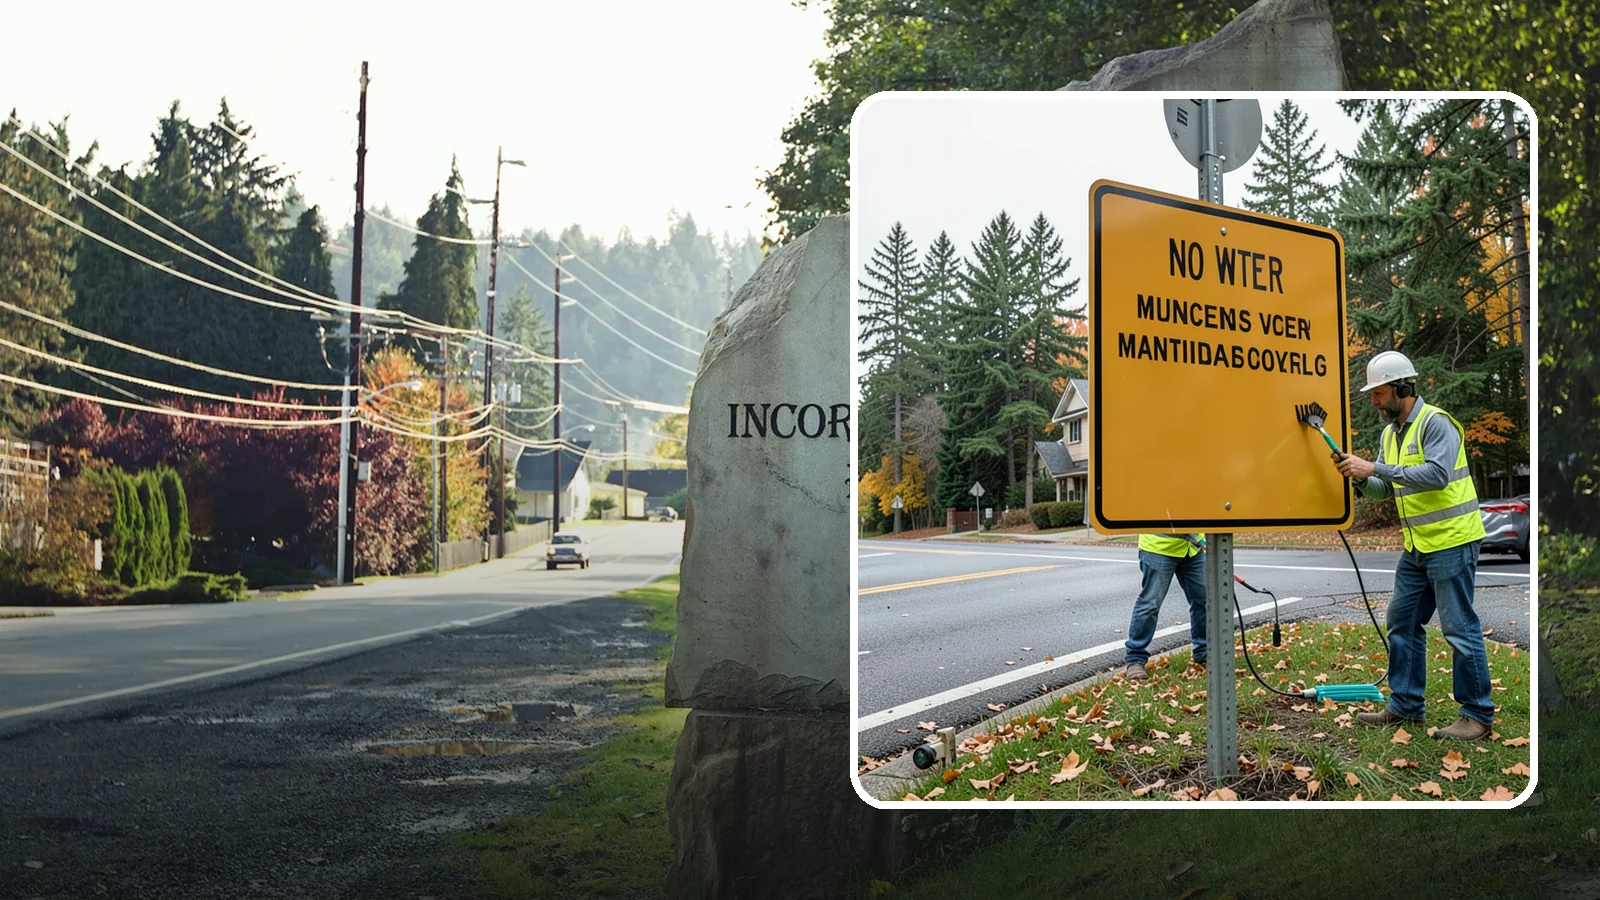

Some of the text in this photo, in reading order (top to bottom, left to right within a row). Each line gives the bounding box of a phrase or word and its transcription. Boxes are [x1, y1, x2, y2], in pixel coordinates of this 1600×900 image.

[1169, 237, 1284, 295] NO WTER
[1137, 293, 1252, 333] MUNCENS
